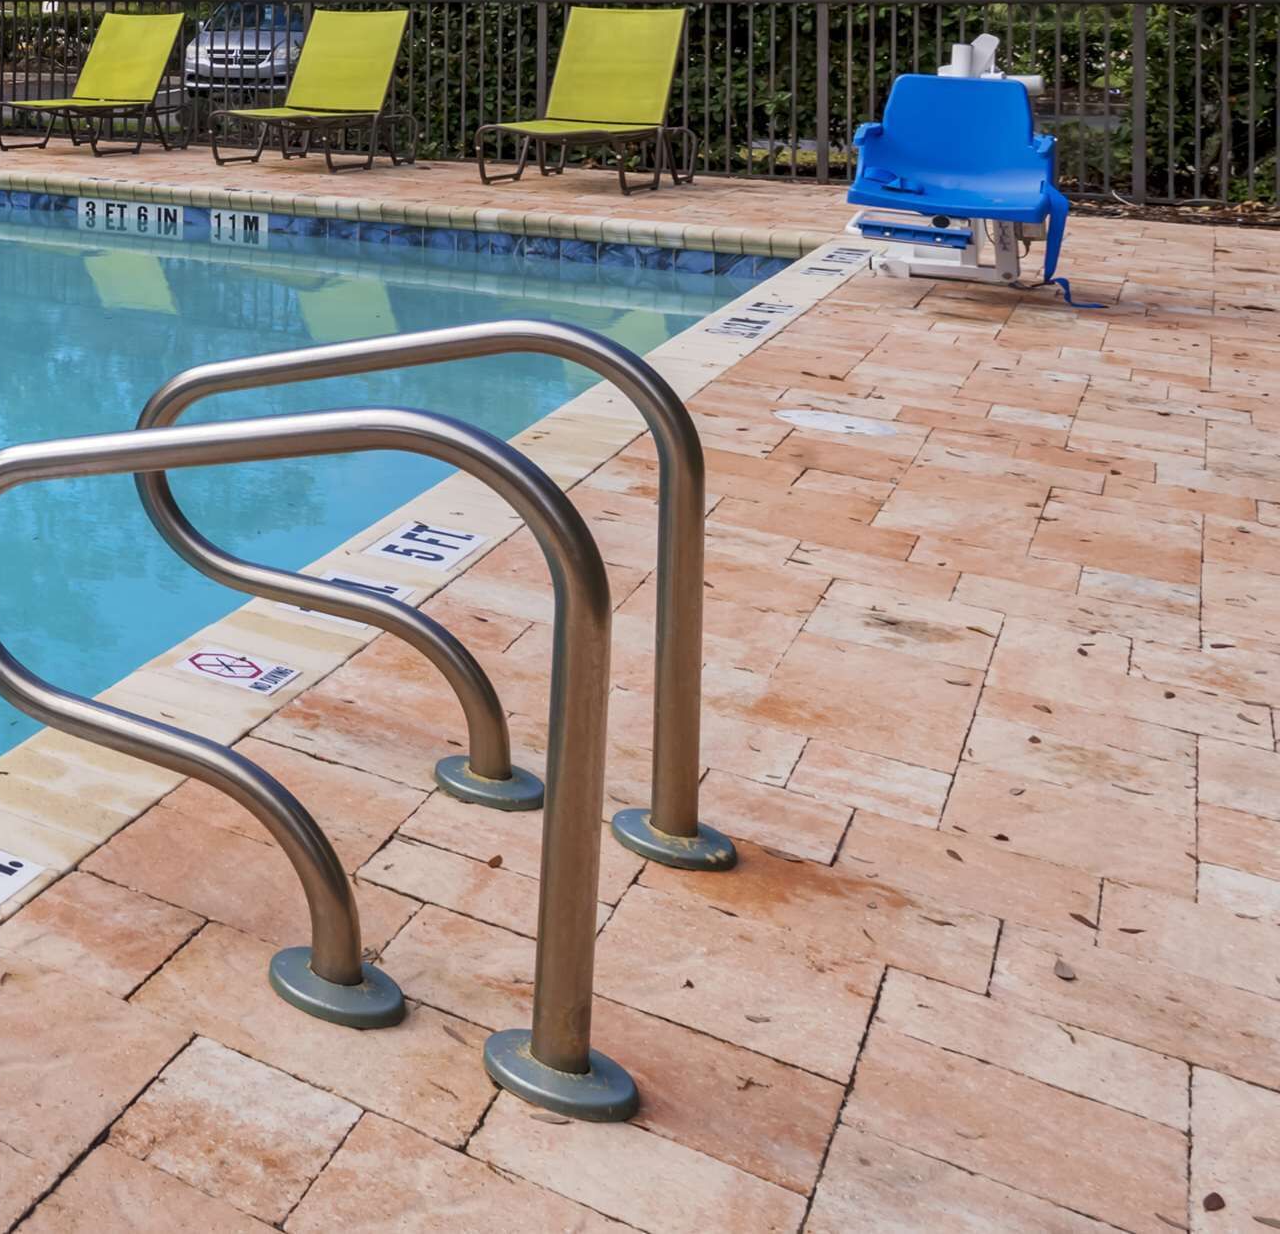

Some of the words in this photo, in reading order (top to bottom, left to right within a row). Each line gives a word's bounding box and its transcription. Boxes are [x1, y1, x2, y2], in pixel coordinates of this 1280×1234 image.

[85, 201, 96, 218] 3
[106, 203, 127, 219] FT
[137, 206, 148, 222] 6
[157, 207, 178, 224] IN
[382, 545, 444, 561] 5
